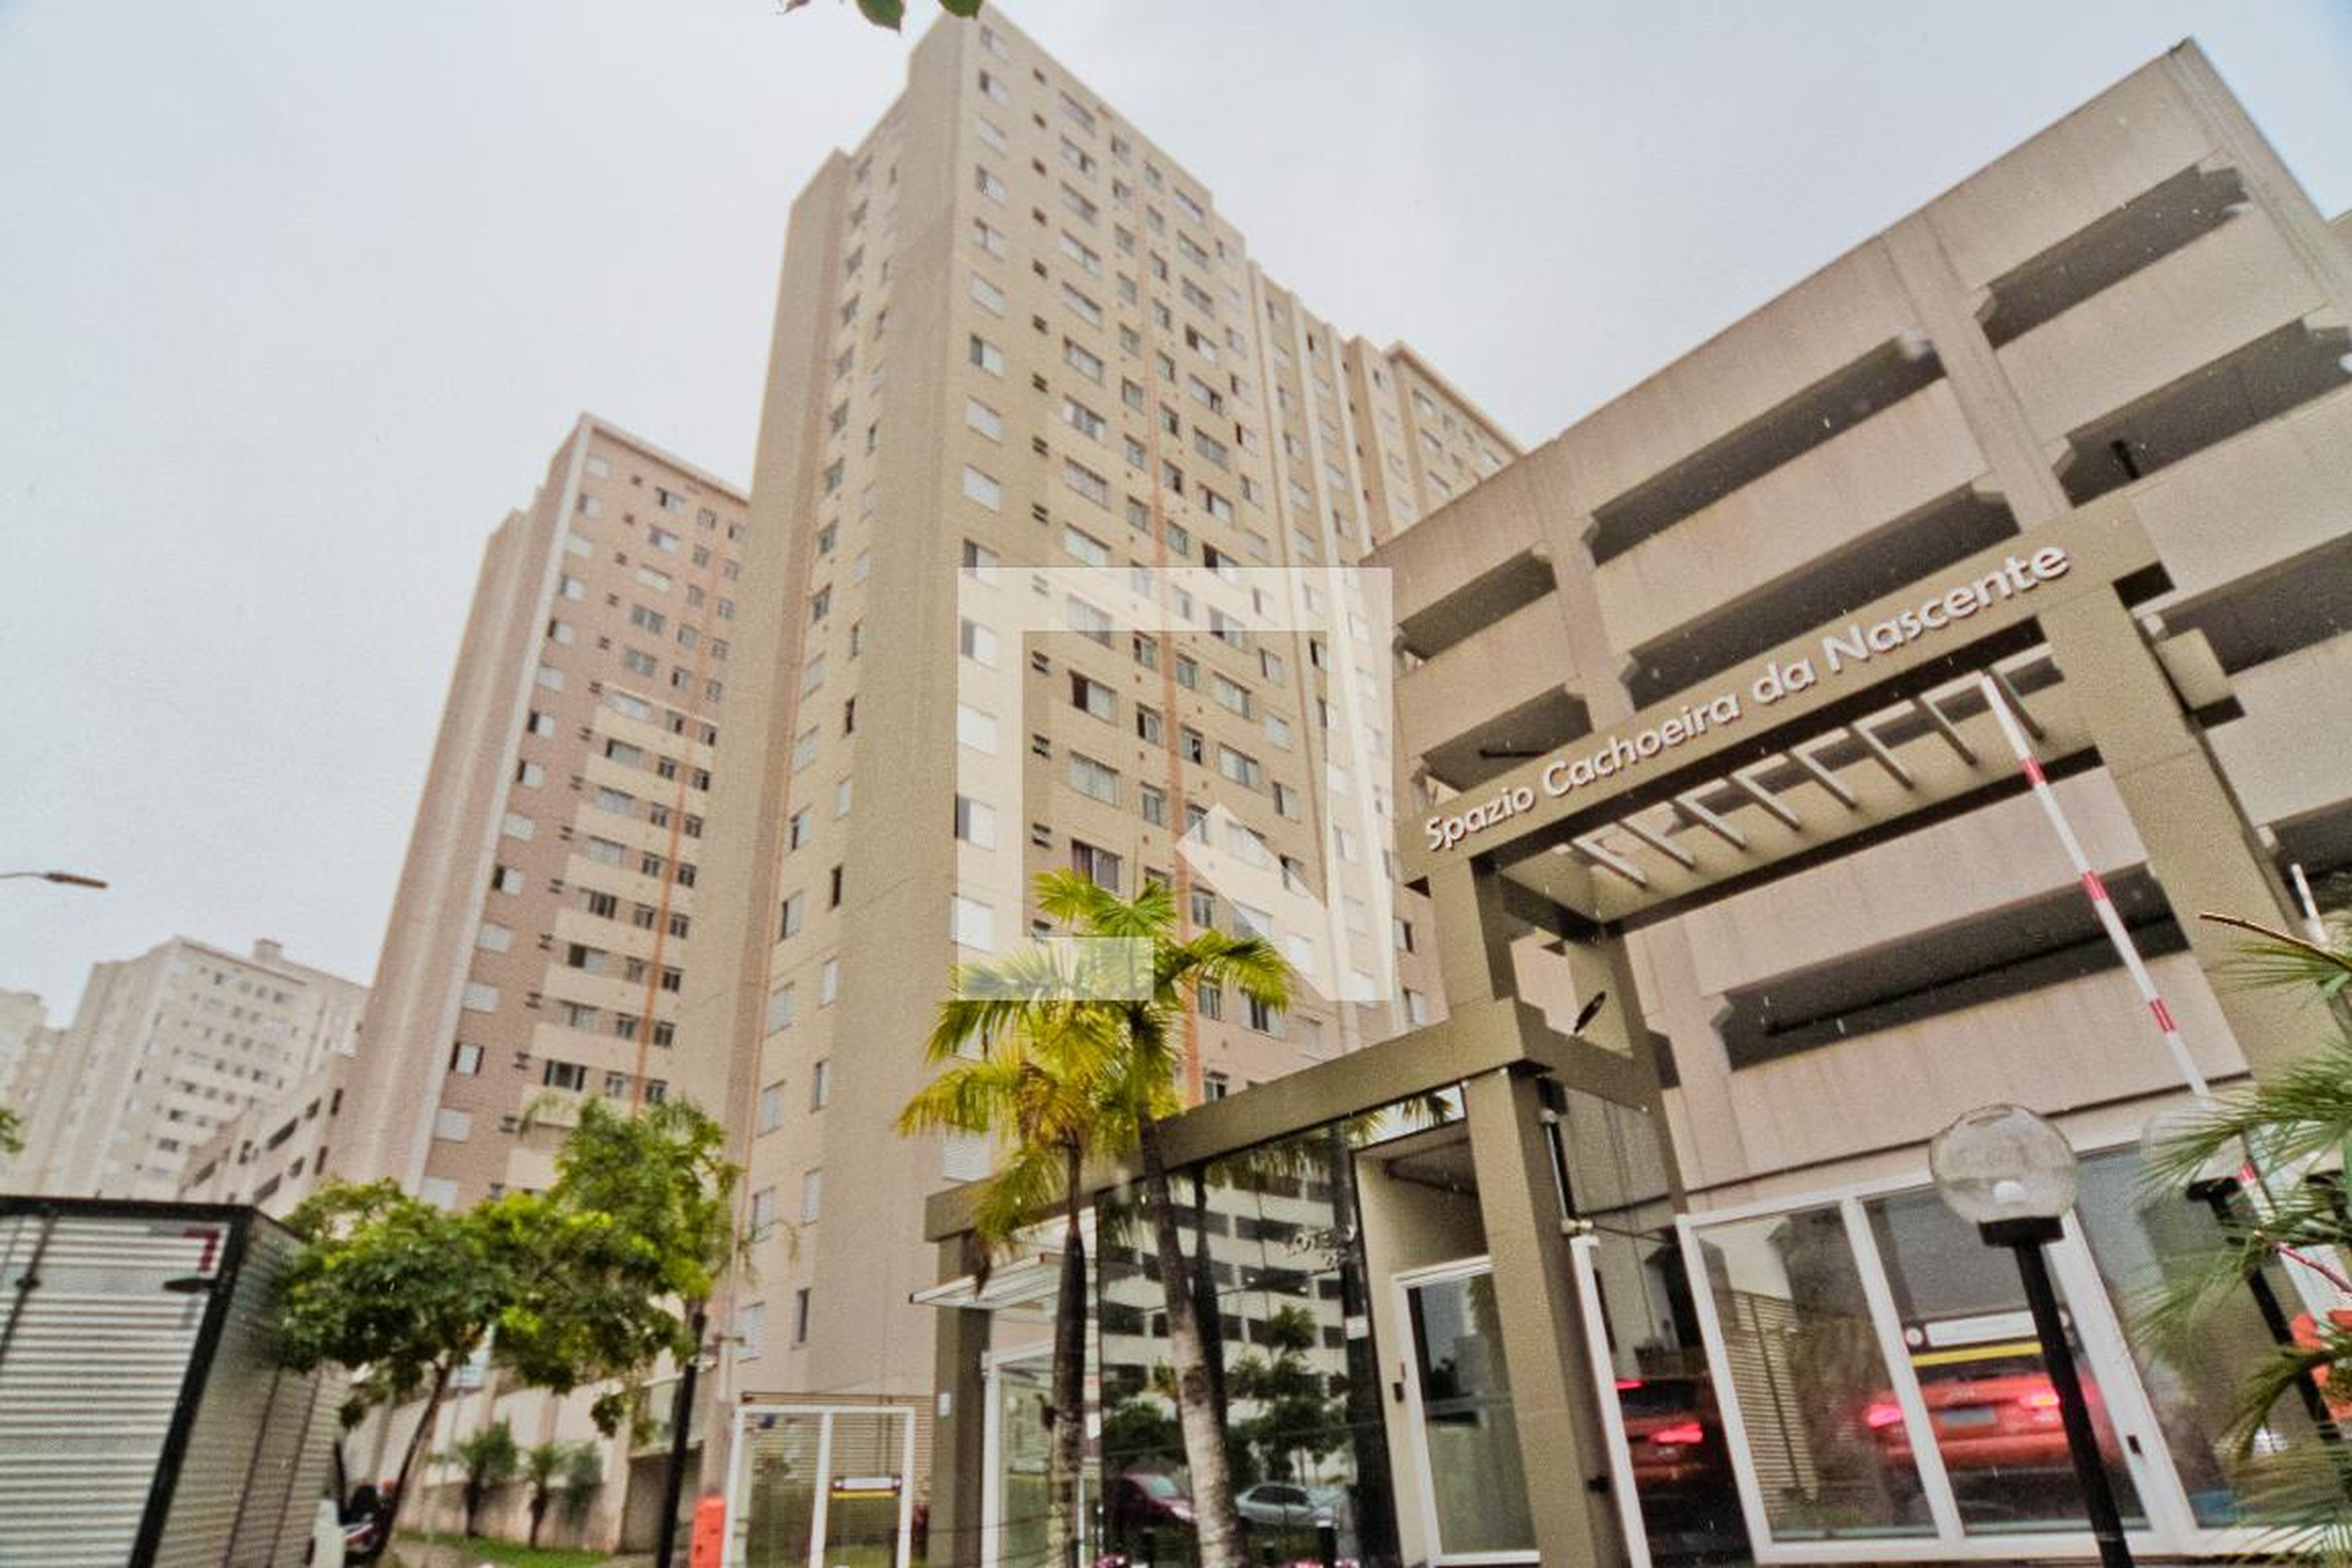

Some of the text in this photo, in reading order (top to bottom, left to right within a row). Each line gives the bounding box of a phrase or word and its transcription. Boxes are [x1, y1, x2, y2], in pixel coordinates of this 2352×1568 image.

[1426, 545, 2071, 851] Spazio Cachoeira da Nascente
